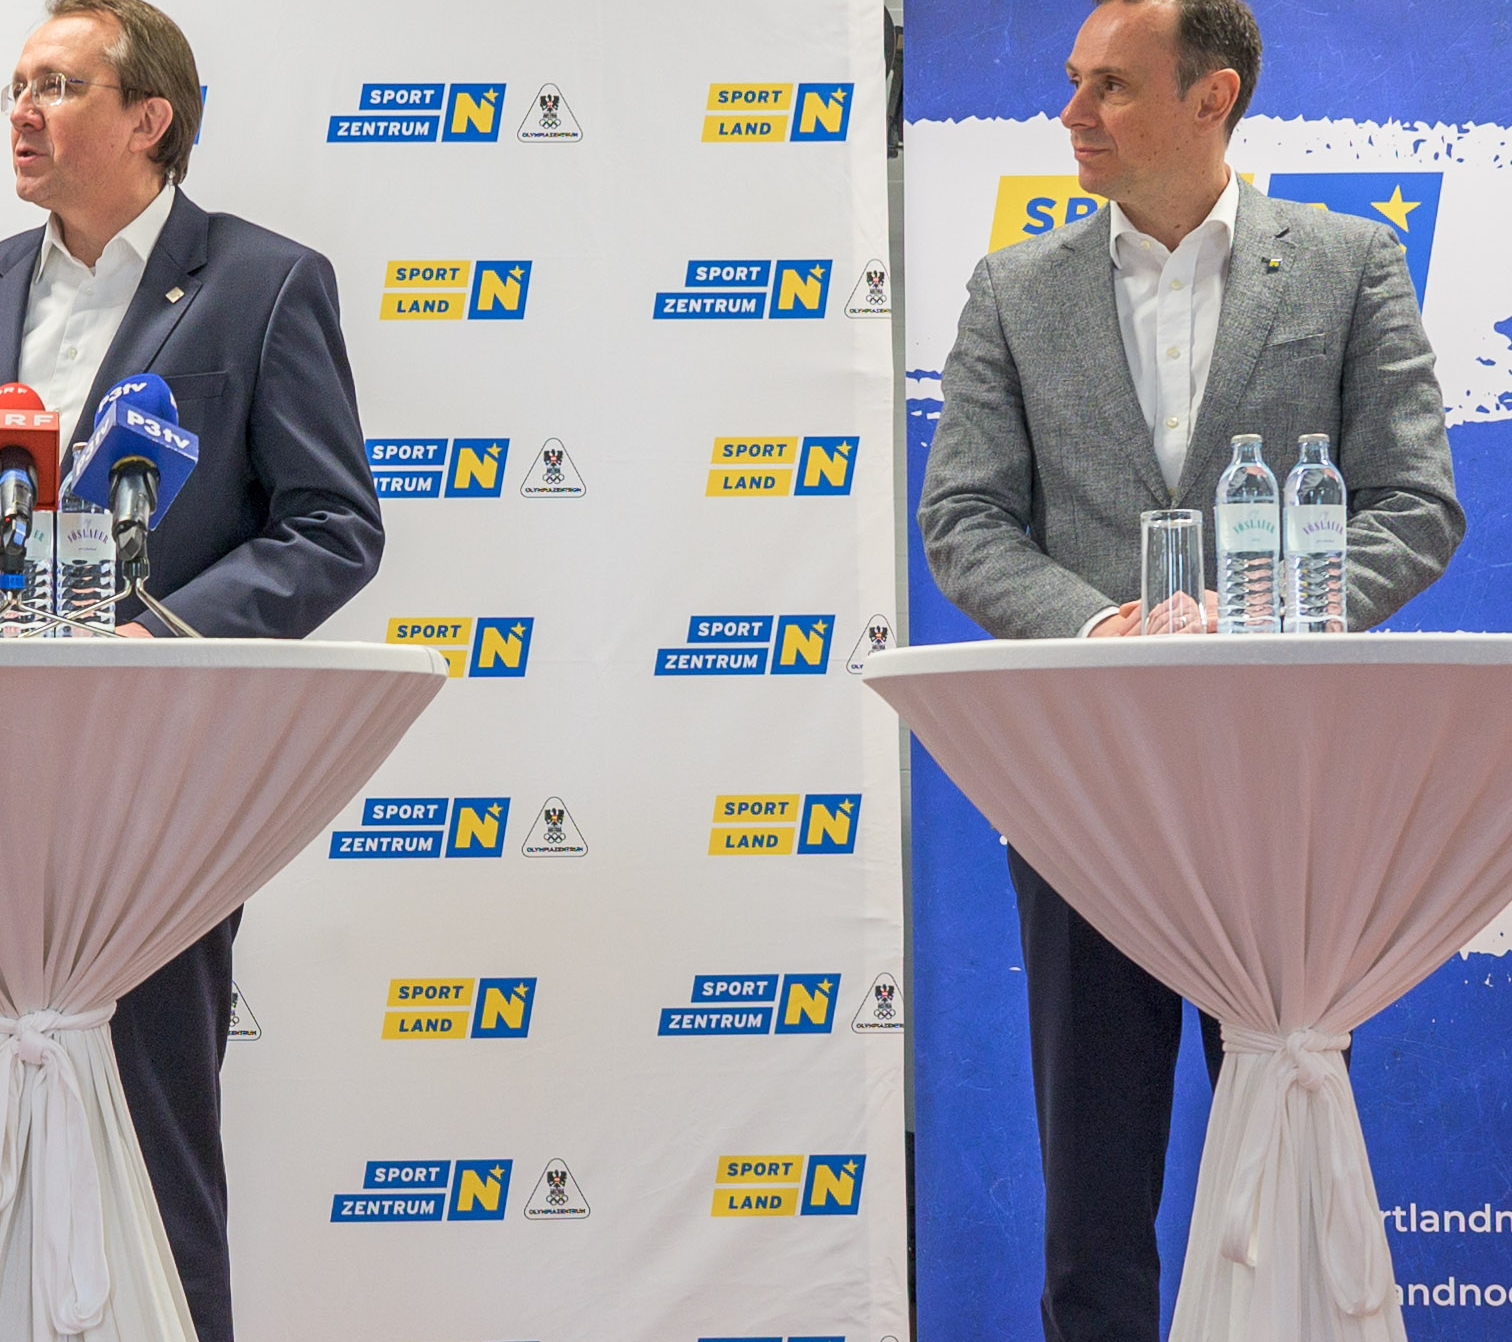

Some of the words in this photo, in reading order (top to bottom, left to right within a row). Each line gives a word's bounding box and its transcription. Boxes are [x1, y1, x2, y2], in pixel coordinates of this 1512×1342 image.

[369, 89, 435, 105] SPORT
[718, 89, 783, 104] SPORT
[336, 121, 430, 137] ZENTRUM
[718, 121, 772, 136] LAND
[395, 267, 460, 281] SPORT
[695, 266, 761, 281] SPORT
[396, 299, 450, 314] LAND
[663, 298, 757, 313] ZENTRUM
[127, 409, 191, 450] P3tv
[371, 444, 438, 460] SPORT
[723, 443, 788, 458] SPORT
[373, 476, 433, 492] TRUM
[723, 476, 776, 490] LAND
[397, 624, 462, 639] SPORT
[697, 621, 763, 637] SPORT
[664, 654, 759, 670] ZENTRUM
[372, 804, 439, 820] SPORT
[724, 801, 790, 816] SPORT
[339, 836, 434, 852] ZENTRUM
[725, 834, 779, 849] LAND
[398, 985, 464, 1000] SPORT
[702, 980, 769, 996] SPORT
[398, 1018, 453, 1033] LAND
[668, 1013, 763, 1029] ZENTRUM
[374, 1166, 441, 1183] SPORT
[727, 1162, 794, 1177] SPORT
[340, 1199, 436, 1216] ZENTRUM
[728, 1195, 783, 1210] LAND
